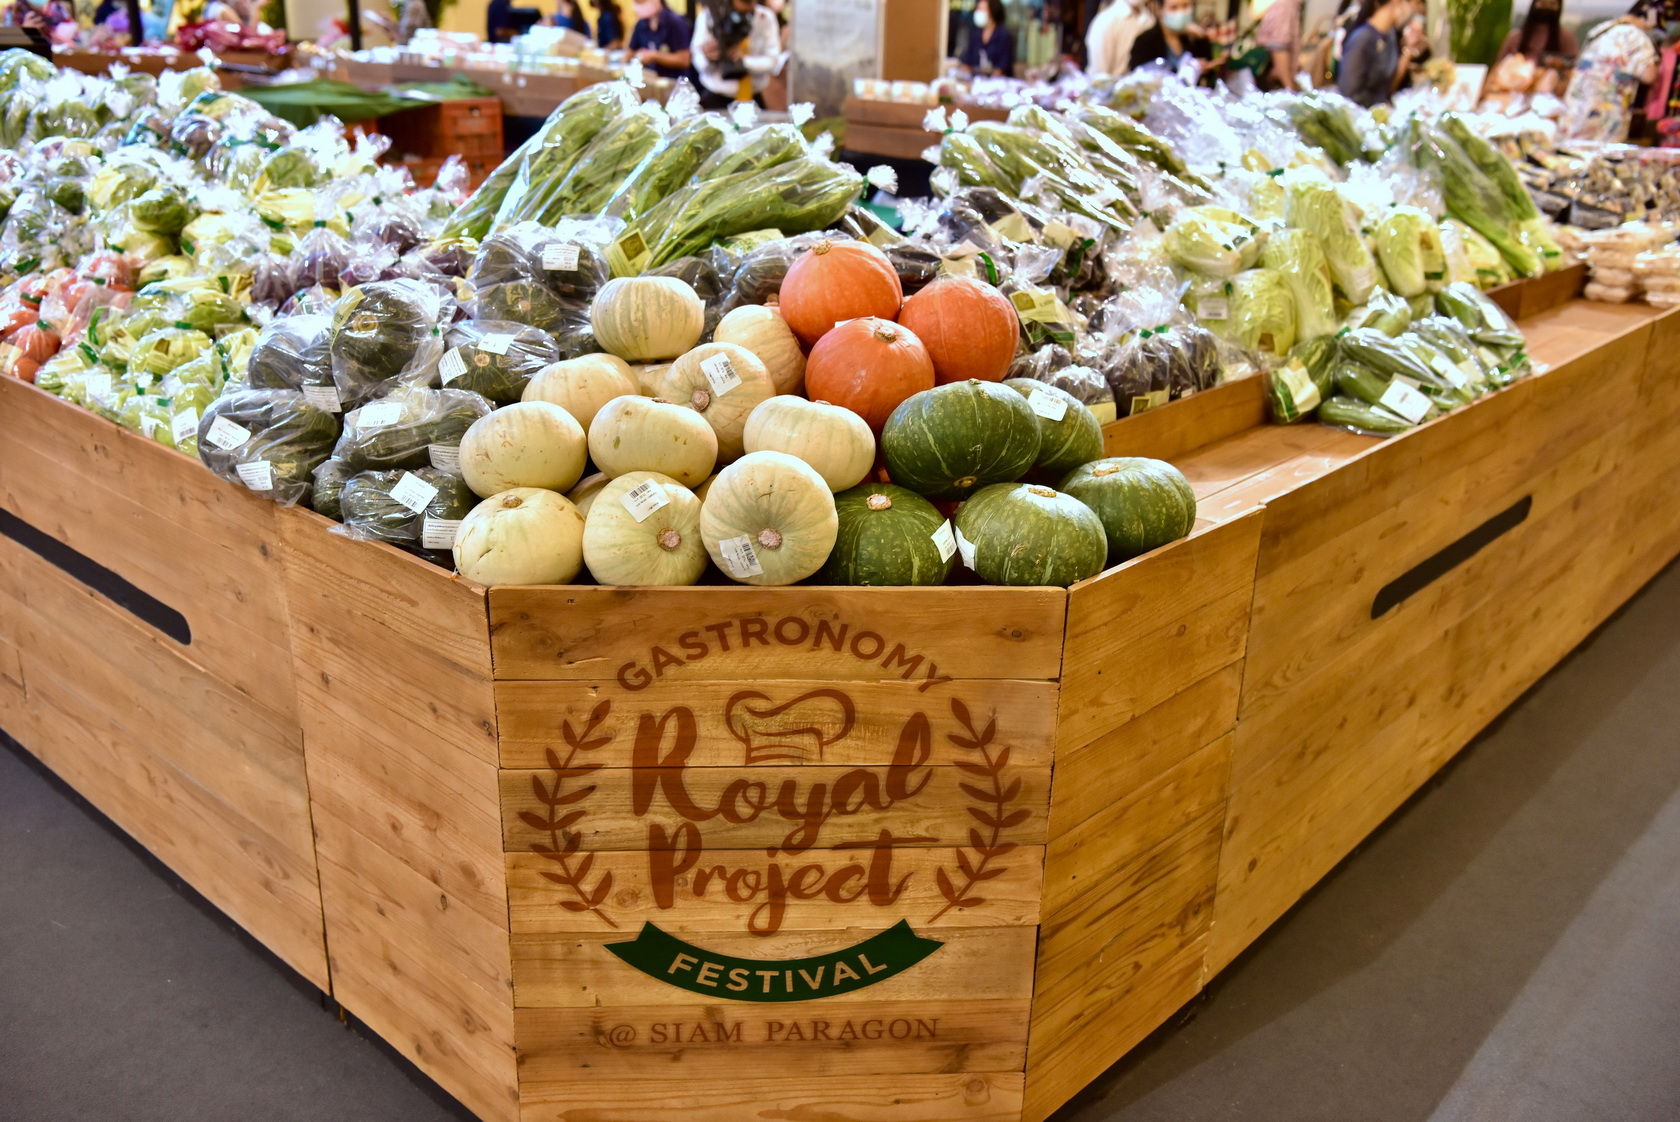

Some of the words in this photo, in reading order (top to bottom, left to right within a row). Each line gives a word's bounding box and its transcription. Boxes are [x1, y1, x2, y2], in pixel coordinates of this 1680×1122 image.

[617, 616, 951, 693] GASTRONOMY
[632, 705, 934, 853] Royal
[650, 822, 939, 936] Project
[667, 952, 888, 994] FESTIVAL
[608, 1026, 638, 1048] @
[650, 1020, 743, 1043] SIAM
[767, 1018, 939, 1042] PARAGON
